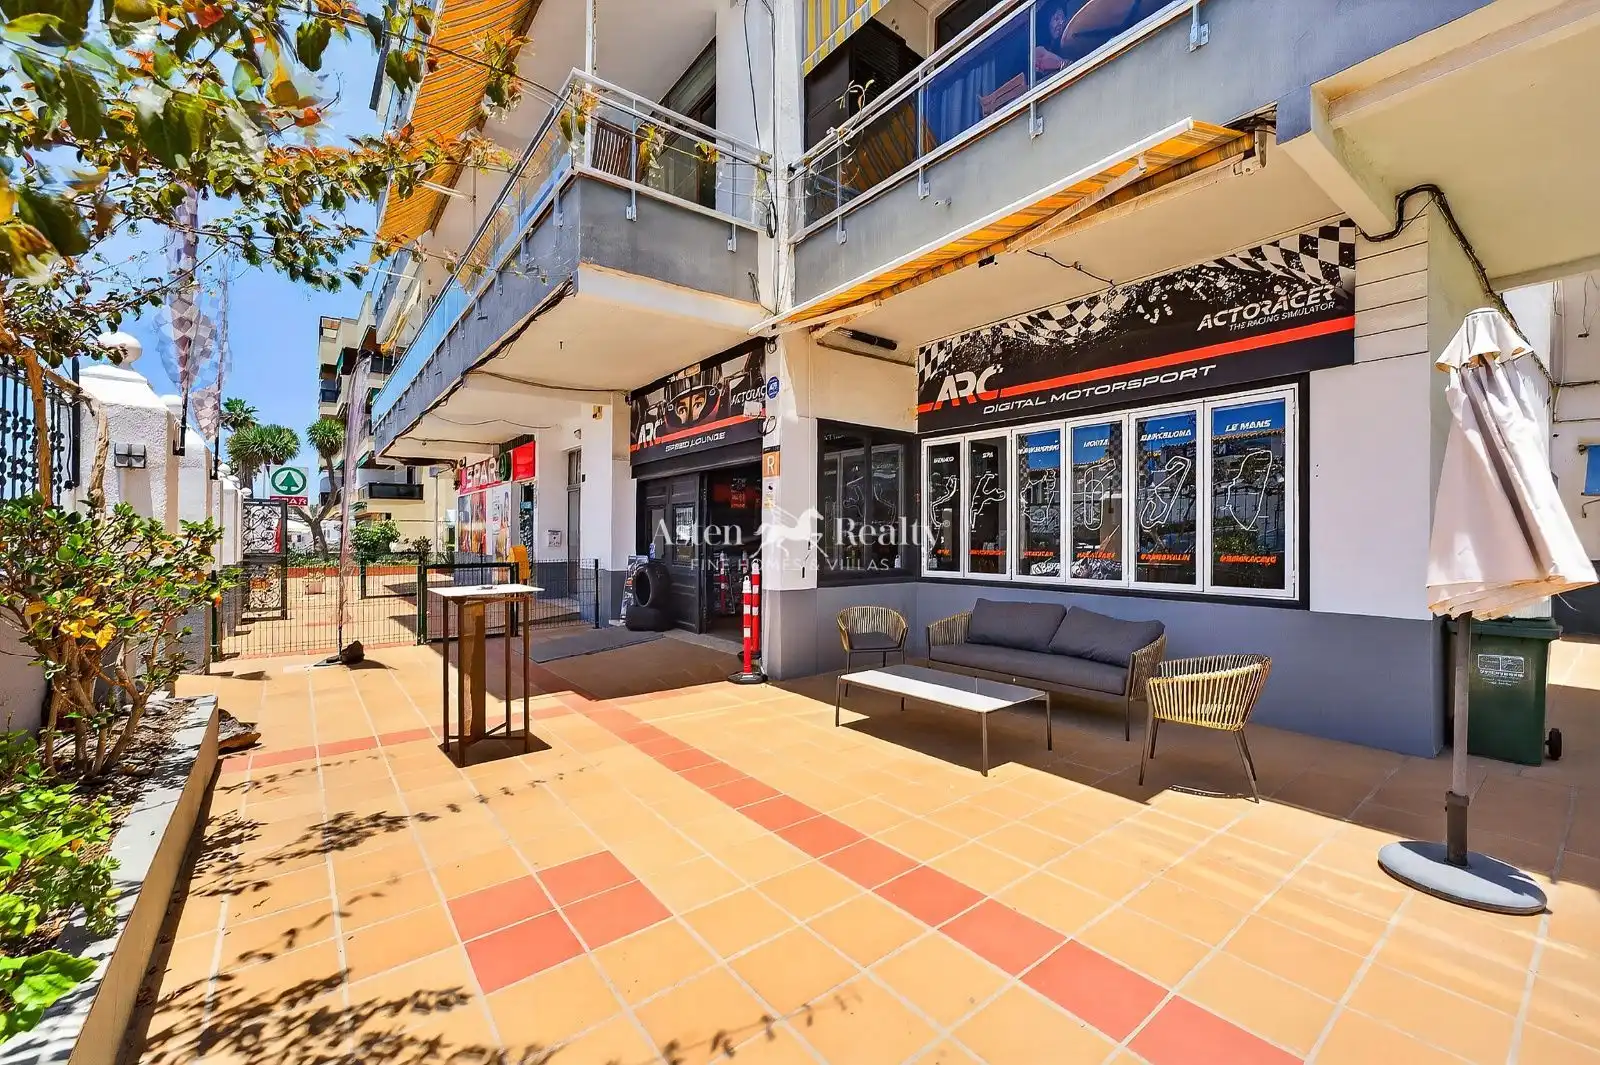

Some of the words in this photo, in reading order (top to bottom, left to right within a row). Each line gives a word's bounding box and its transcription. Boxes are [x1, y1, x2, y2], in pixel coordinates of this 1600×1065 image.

[1197, 284, 1335, 331] ACTORACER
[1229, 322, 1246, 331] THE
[1246, 314, 1280, 328] RACING
[1281, 301, 1336, 321] SIMULATOR
[933, 365, 1003, 411] ARC
[983, 397, 1047, 415] DIGITAL
[1050, 364, 1217, 404] MOTORSPORT
[636, 417, 664, 448] ARC
[1240, 419, 1272, 430] MANS
[466, 457, 499, 489] SPAR
[767, 455, 775, 475] R
[270, 497, 307, 505] AR
